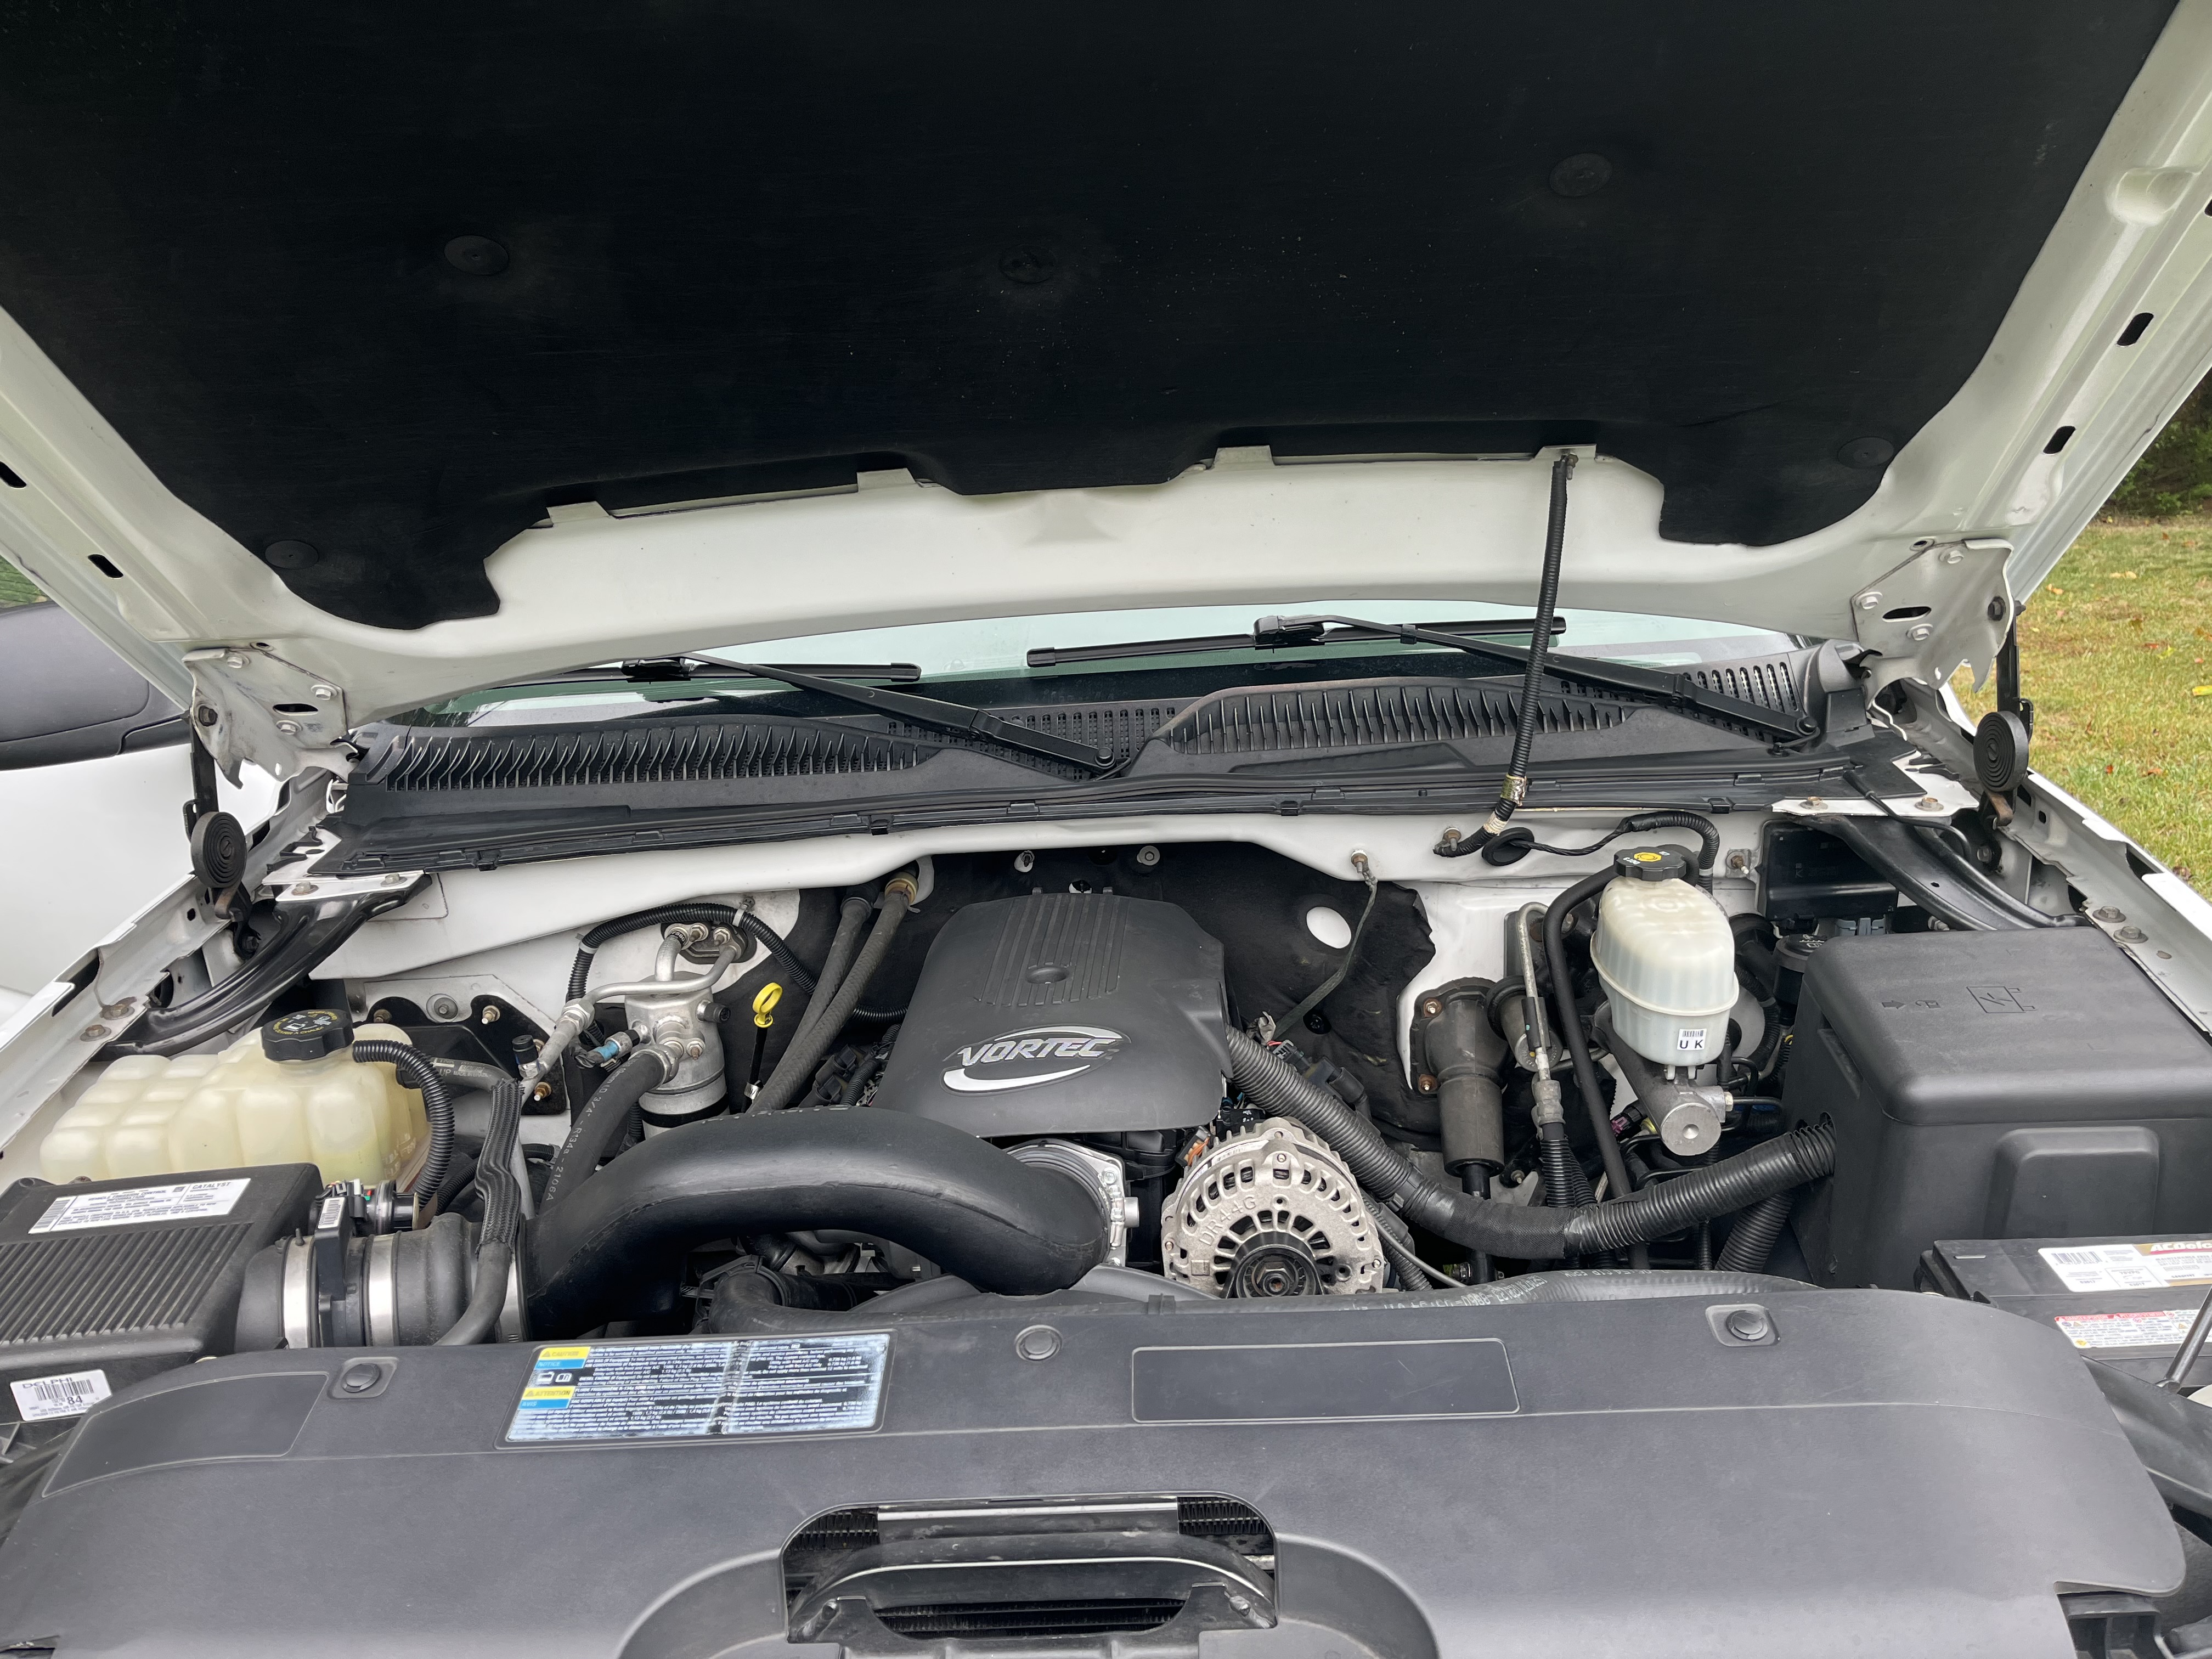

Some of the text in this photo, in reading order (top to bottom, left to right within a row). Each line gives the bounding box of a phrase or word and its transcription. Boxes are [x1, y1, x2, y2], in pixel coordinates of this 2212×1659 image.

[957, 1037, 1116, 1066] VORTEC
[191, 1182, 232, 1190] CATALYST
[2150, 1241, 2212, 1252] ACDelc
[22, 1377, 73, 1389] DELPHI
[67, 1396, 83, 1405] 84
